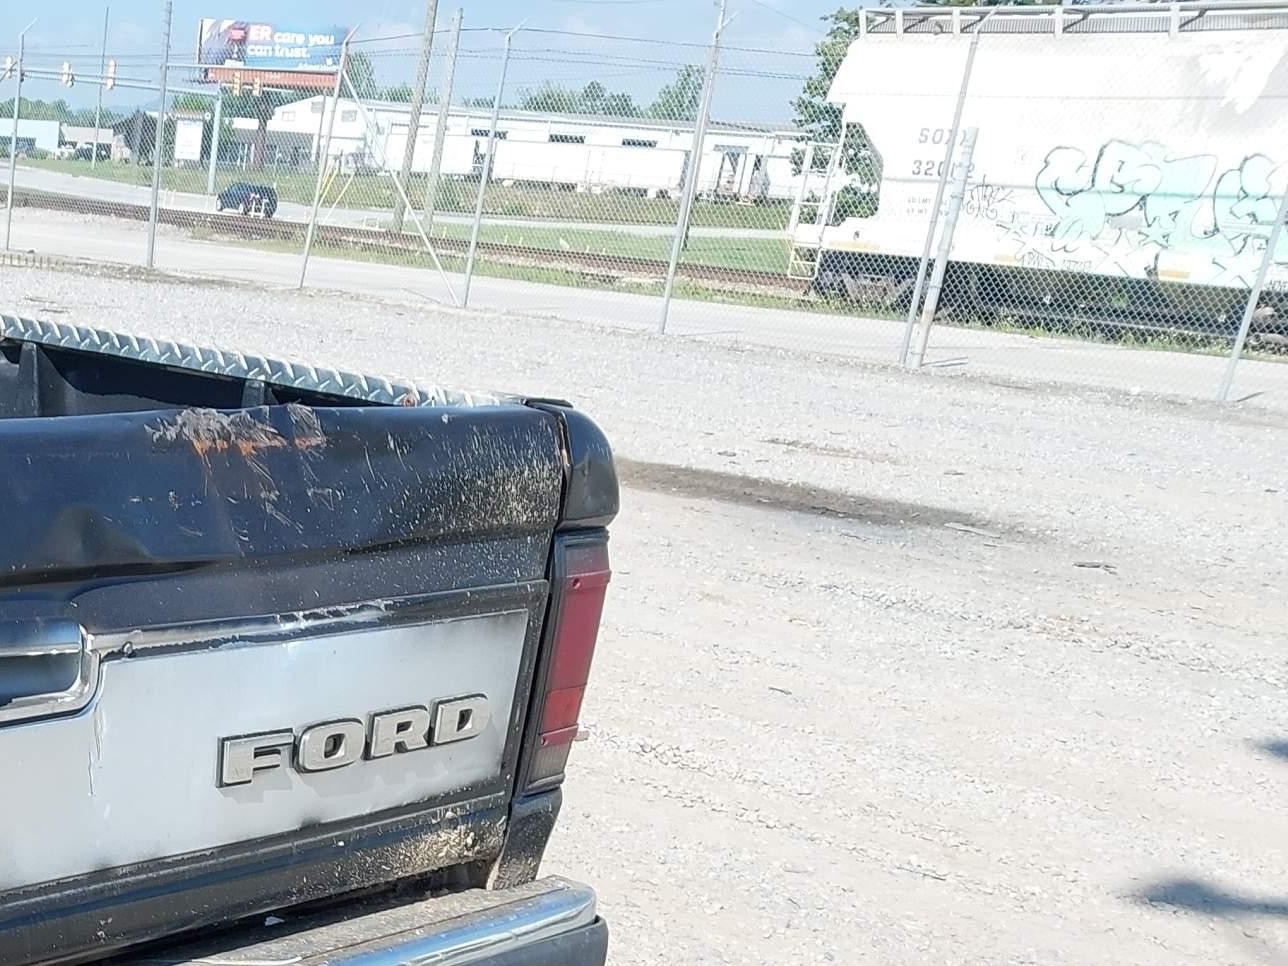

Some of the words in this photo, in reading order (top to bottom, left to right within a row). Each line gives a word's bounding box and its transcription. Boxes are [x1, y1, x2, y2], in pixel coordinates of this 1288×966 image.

[248, 25, 272, 41] ER
[274, 31, 305, 45] care
[308, 32, 335, 47] you
[247, 44, 272, 57] can
[273, 44, 311, 58] trust.
[215, 692, 489, 788] FORD
